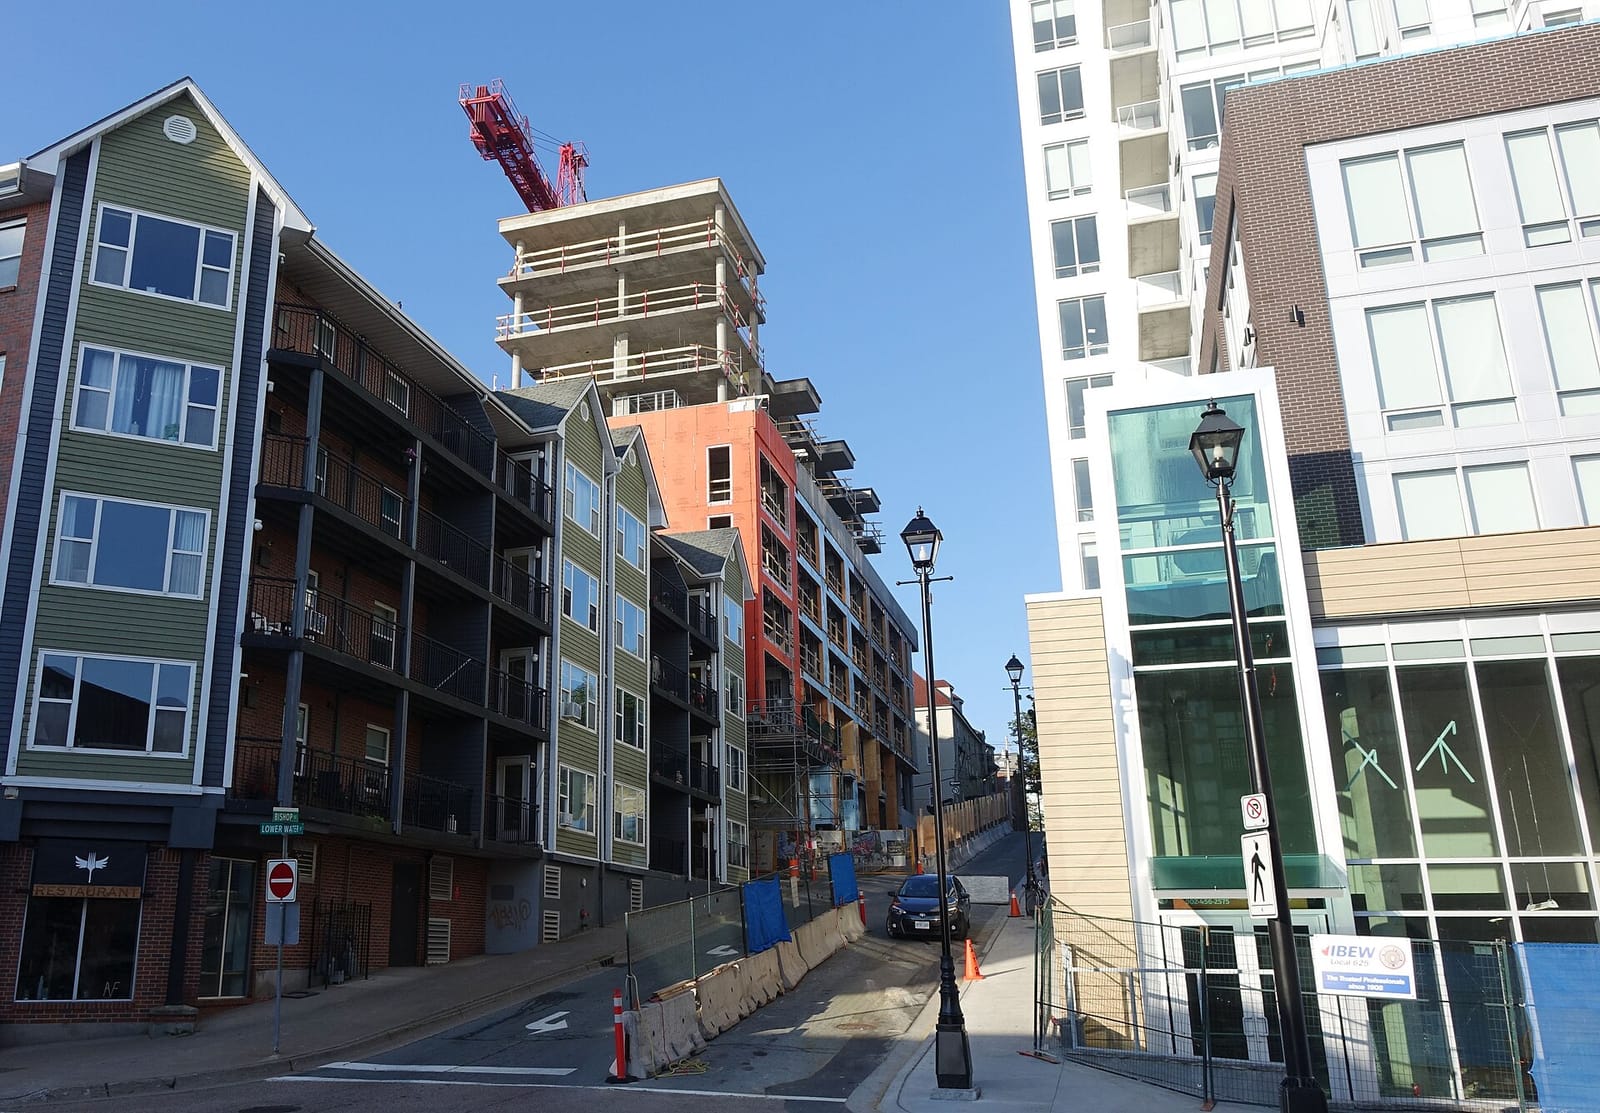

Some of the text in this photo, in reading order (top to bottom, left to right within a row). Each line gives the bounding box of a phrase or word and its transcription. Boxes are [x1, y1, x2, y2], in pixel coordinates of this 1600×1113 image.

[274, 812, 293, 821] BISHOP
[261, 824, 283, 833] LOWER
[283, 824, 299, 833] WATER
[34, 885, 140, 897] RESTAURANT
[1331, 945, 1375, 958] IBEW
[1330, 958, 1369, 967] Local 625
[1339, 975, 1362, 983] Trusted
[1363, 976, 1405, 985] Professionals
